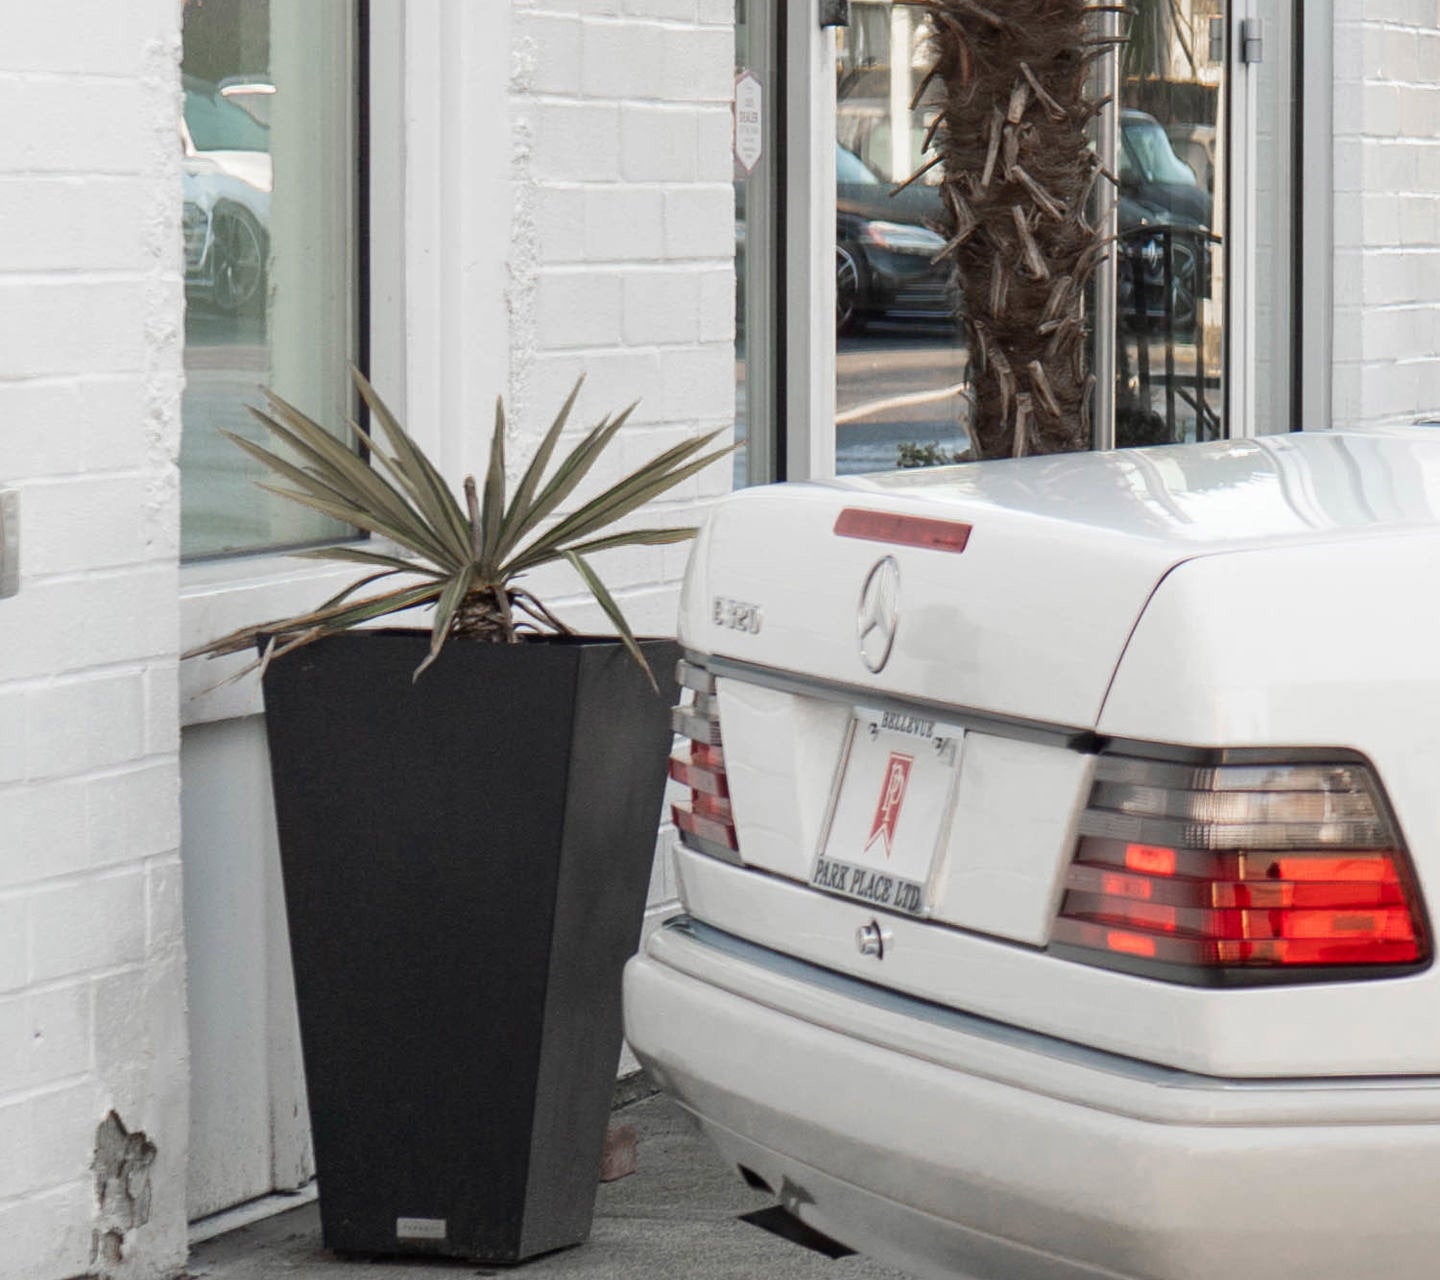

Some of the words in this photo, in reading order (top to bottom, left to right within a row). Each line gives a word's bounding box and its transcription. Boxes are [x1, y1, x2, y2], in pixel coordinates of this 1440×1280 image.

[881, 711, 936, 738] BELLEVUE
[813, 859, 849, 890] PARK
[849, 869, 893, 903] PLACE
[893, 880, 922, 912] LTD
